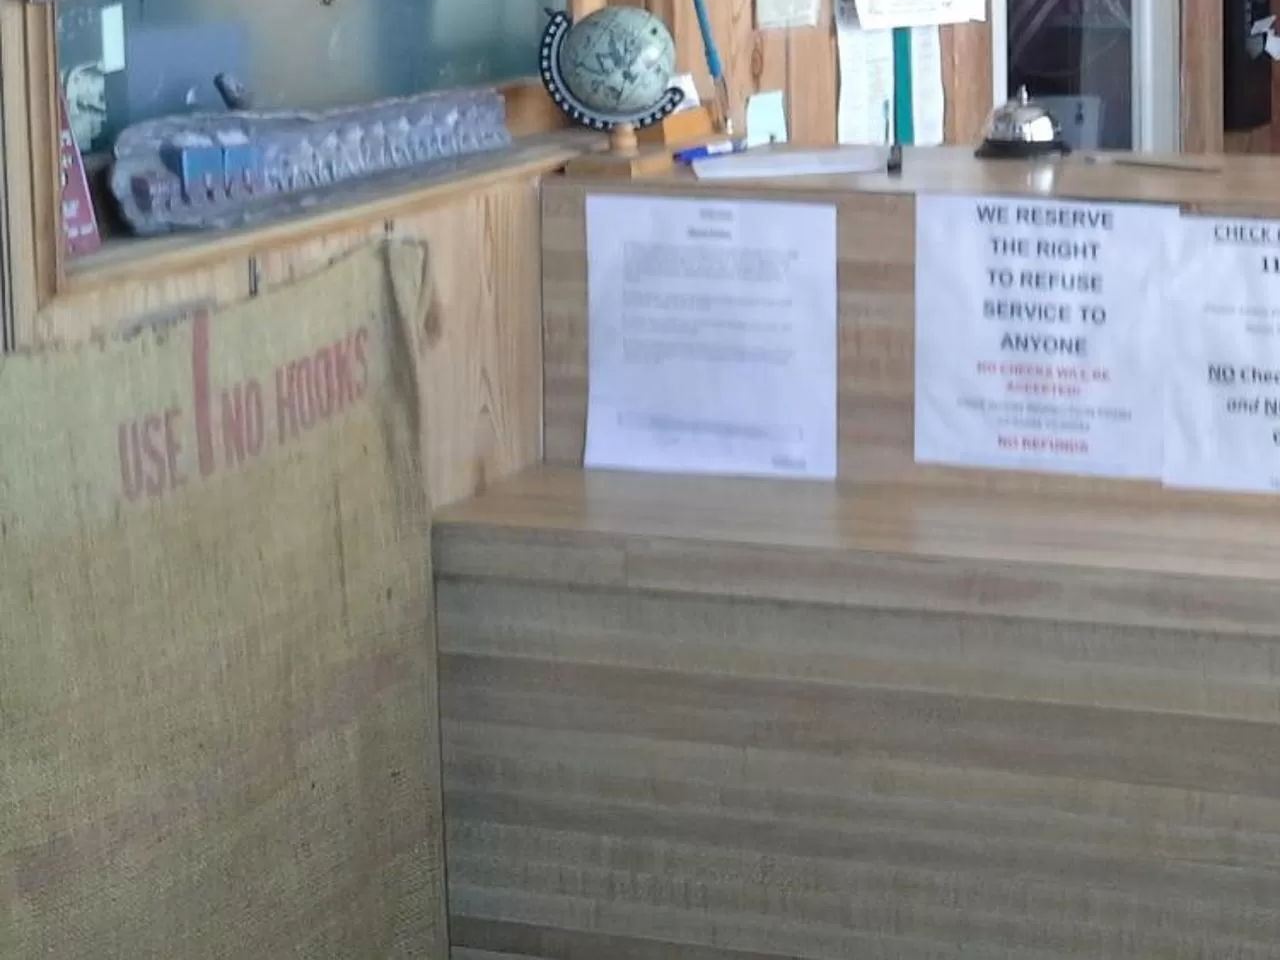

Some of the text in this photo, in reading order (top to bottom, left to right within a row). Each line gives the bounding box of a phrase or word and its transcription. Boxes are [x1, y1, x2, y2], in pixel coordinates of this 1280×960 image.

[976, 204, 1114, 230] WE RESERVE
[1213, 223, 1270, 243] CHECK
[991, 238, 1101, 260] THE RIGHT
[987, 268, 1103, 293] TO REFUSE
[982, 299, 1107, 325] SERVICE TO
[1000, 332, 1088, 357] ANYONE
[1207, 363, 1236, 385] NO
[118, 326, 369, 502] USE NO HOOKS
[1227, 397, 1260, 415] and
